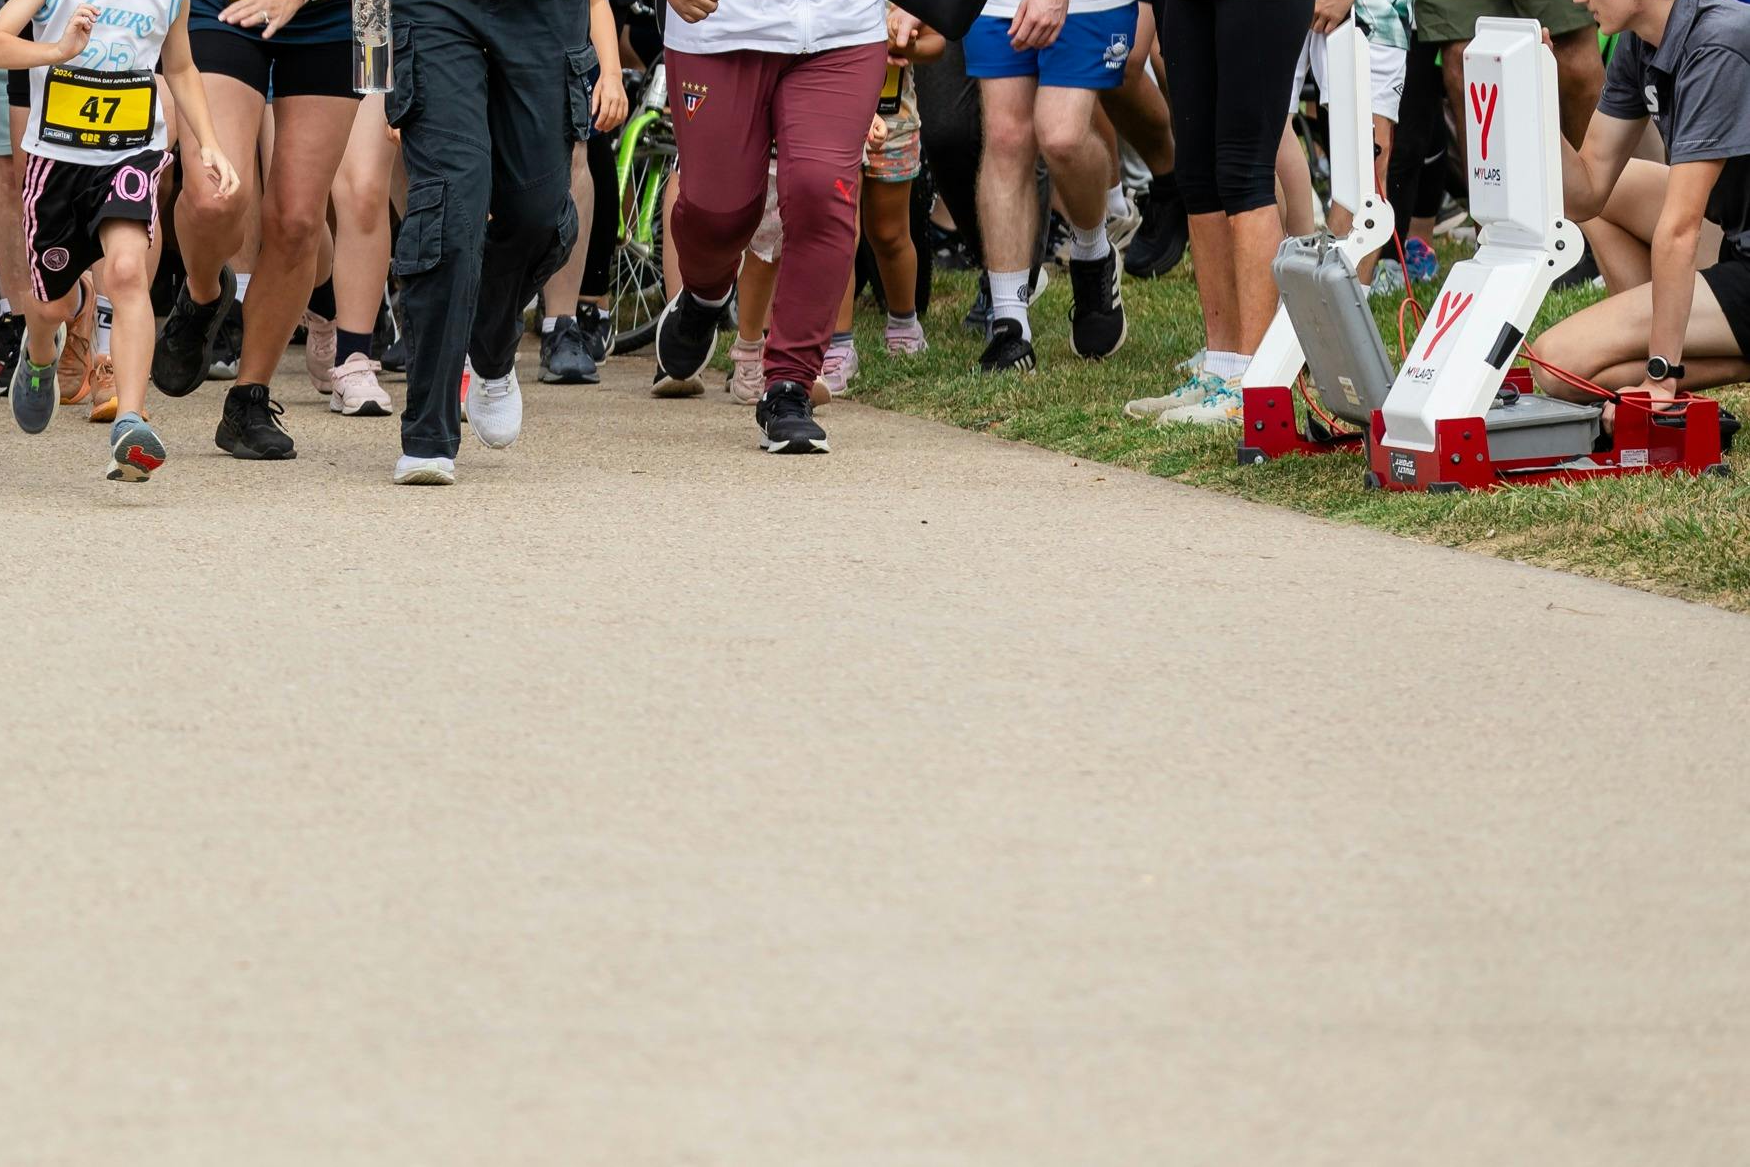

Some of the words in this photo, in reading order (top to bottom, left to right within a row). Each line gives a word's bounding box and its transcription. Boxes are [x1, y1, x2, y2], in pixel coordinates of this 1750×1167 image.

[53, 67, 73, 78] 2024
[73, 74, 102, 84] CANBERRA
[79, 96, 121, 124] 47
[1474, 167, 1501, 181] MYLAPS
[1406, 366, 1435, 380] MYLAPS
